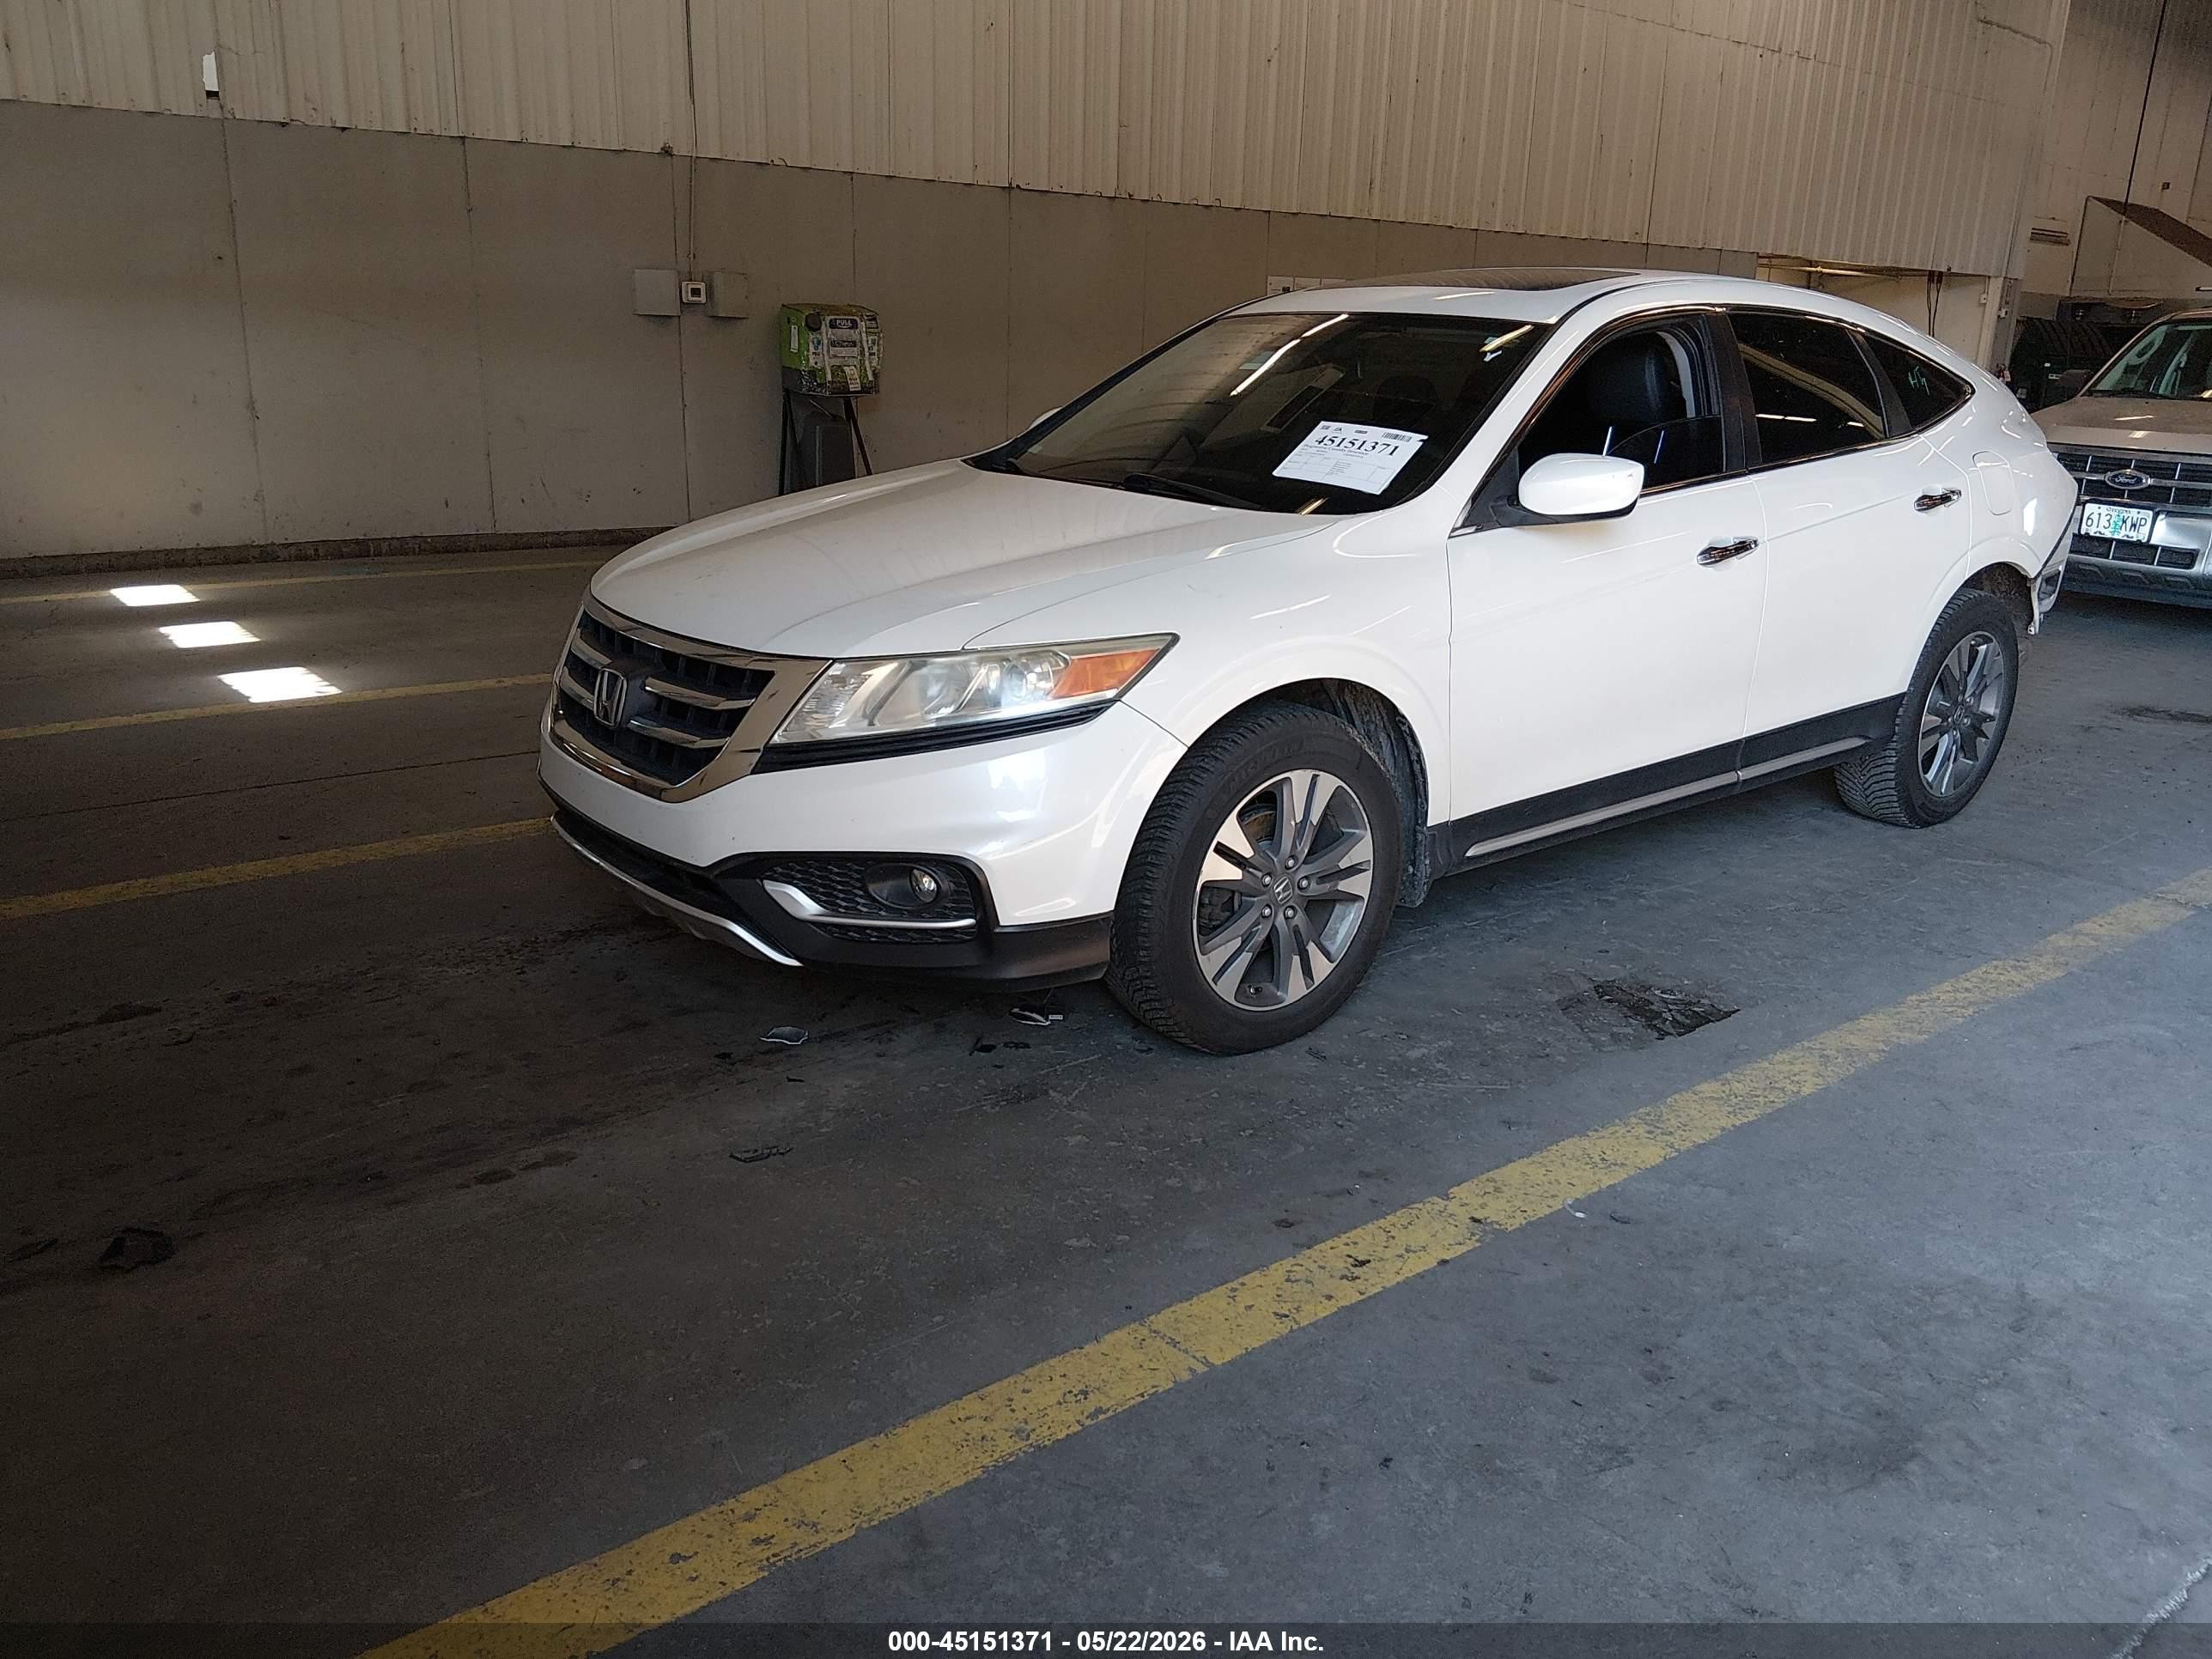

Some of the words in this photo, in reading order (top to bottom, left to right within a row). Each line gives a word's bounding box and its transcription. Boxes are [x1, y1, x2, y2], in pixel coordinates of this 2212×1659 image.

[1315, 434, 1401, 456] 45151371
[2115, 475, 2137, 484] Ford
[2086, 512, 2112, 529] 613
[2119, 515, 2148, 534] KWP
